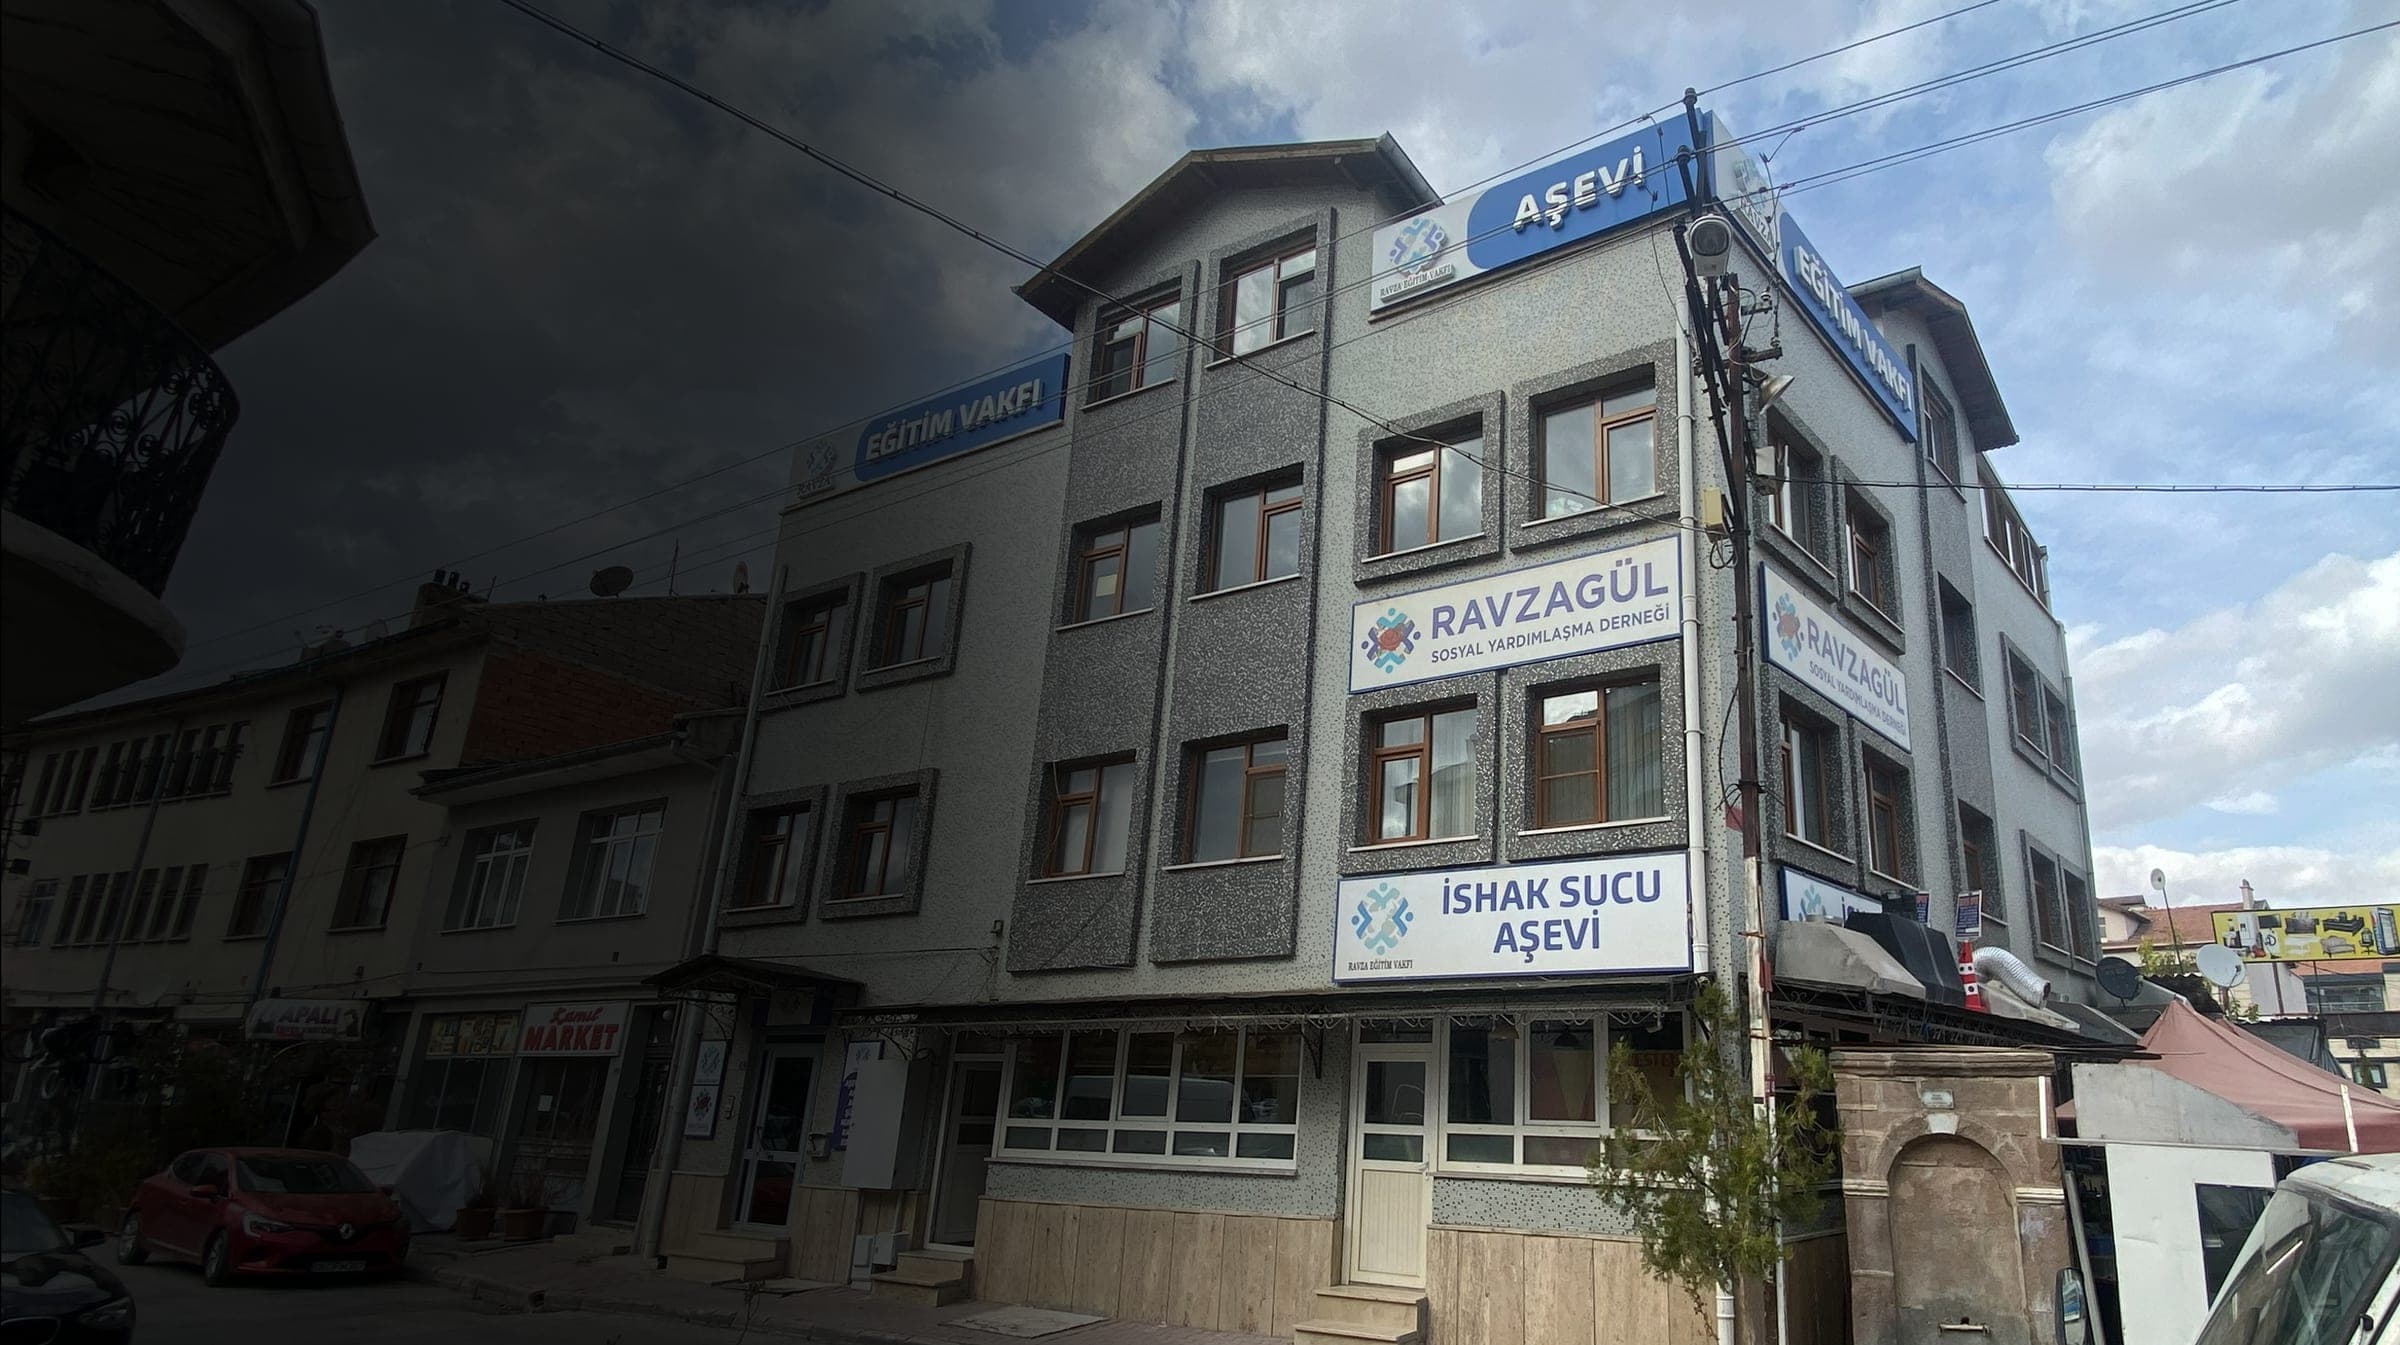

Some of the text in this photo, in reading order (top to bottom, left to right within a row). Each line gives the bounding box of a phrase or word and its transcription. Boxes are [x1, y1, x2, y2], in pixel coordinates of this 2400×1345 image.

[1513, 146, 1643, 229] AŞEVİ
[1796, 246, 1912, 412] EĞİTİM VAKFI
[866, 378, 1040, 461] EĞİTİM VAKFI
[1431, 558, 1669, 639] RAVZAGÜL
[1431, 603, 1670, 663] SOSYAL YARDIMLAŞMA DERNEĞİ
[1807, 618, 1904, 716] RAVZAGÜL
[1442, 870, 1661, 915] İSHAK SUCU
[1348, 958, 1413, 971] RAVZA EĞİTİM VAKFI
[1493, 909, 1600, 964] AŞEVİ
[523, 1023, 619, 1051] MARKET
